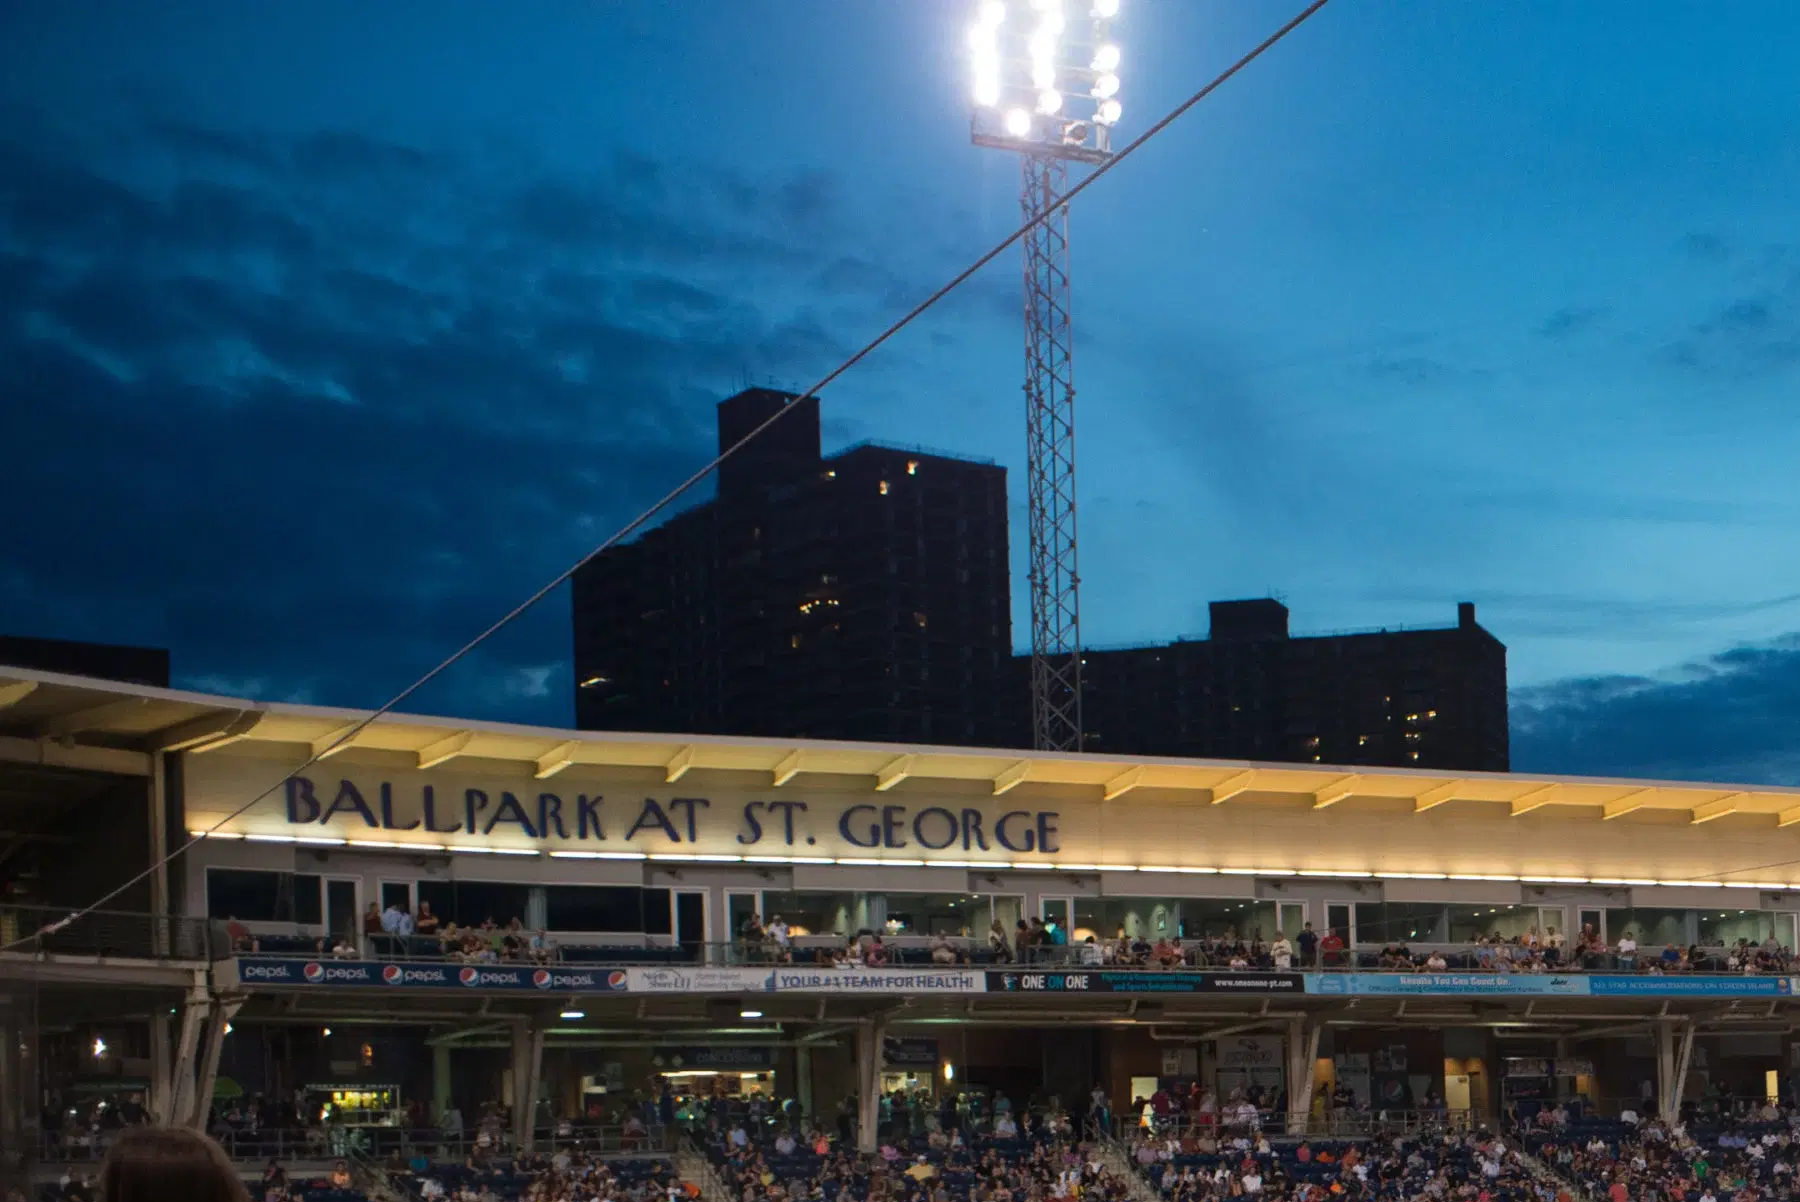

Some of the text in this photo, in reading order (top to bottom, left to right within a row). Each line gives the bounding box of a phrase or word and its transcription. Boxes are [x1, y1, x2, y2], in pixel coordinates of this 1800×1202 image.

[286, 775, 1060, 854] BALLPARK AT ST. GEORGE
[781, 975, 821, 988] YOUR
[842, 975, 884, 988] TEAM
[886, 976, 914, 988] FOR
[916, 975, 974, 989] HEALTH!
[1021, 975, 1089, 989] ONE ON ONE
